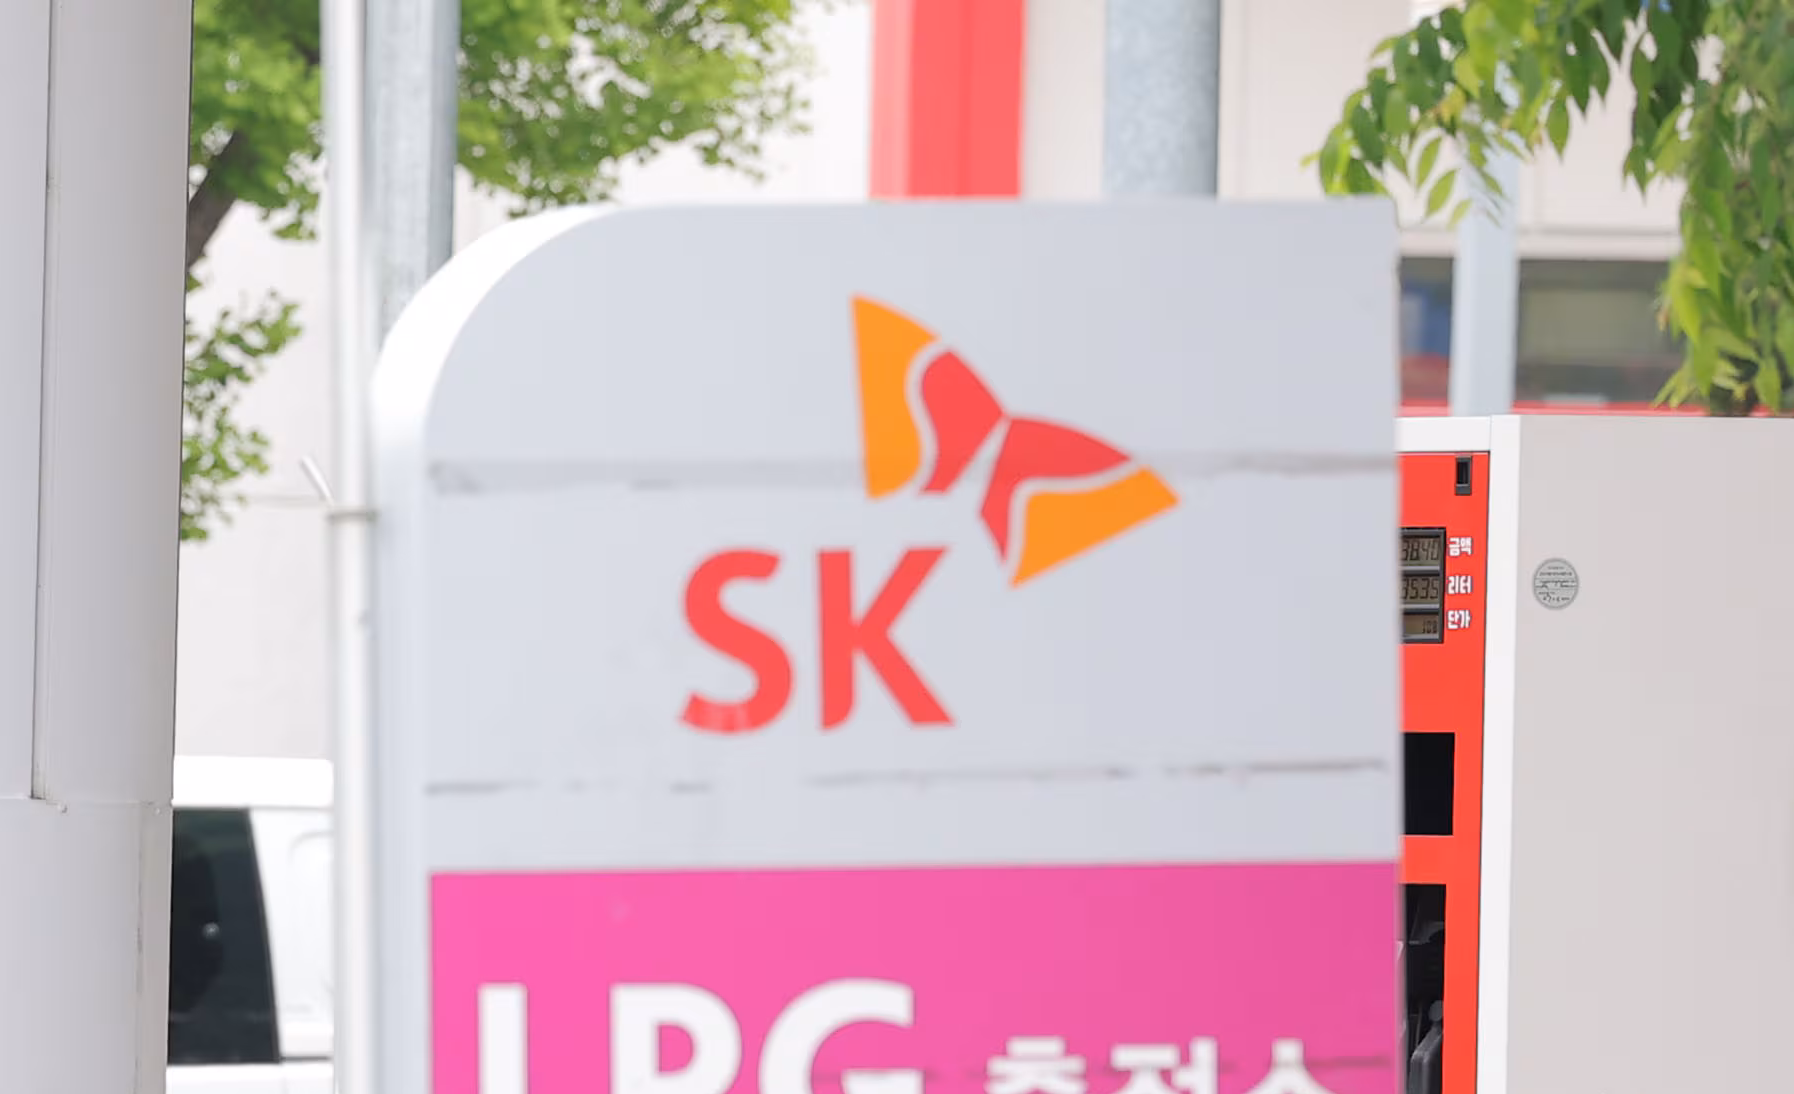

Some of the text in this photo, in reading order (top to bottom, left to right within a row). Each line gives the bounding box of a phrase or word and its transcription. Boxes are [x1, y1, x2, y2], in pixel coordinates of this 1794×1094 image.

[1448, 536, 1472, 557] 금액
[1447, 575, 1472, 595] 리터
[1447, 609, 1471, 630] 단가
[680, 545, 954, 735] SK
